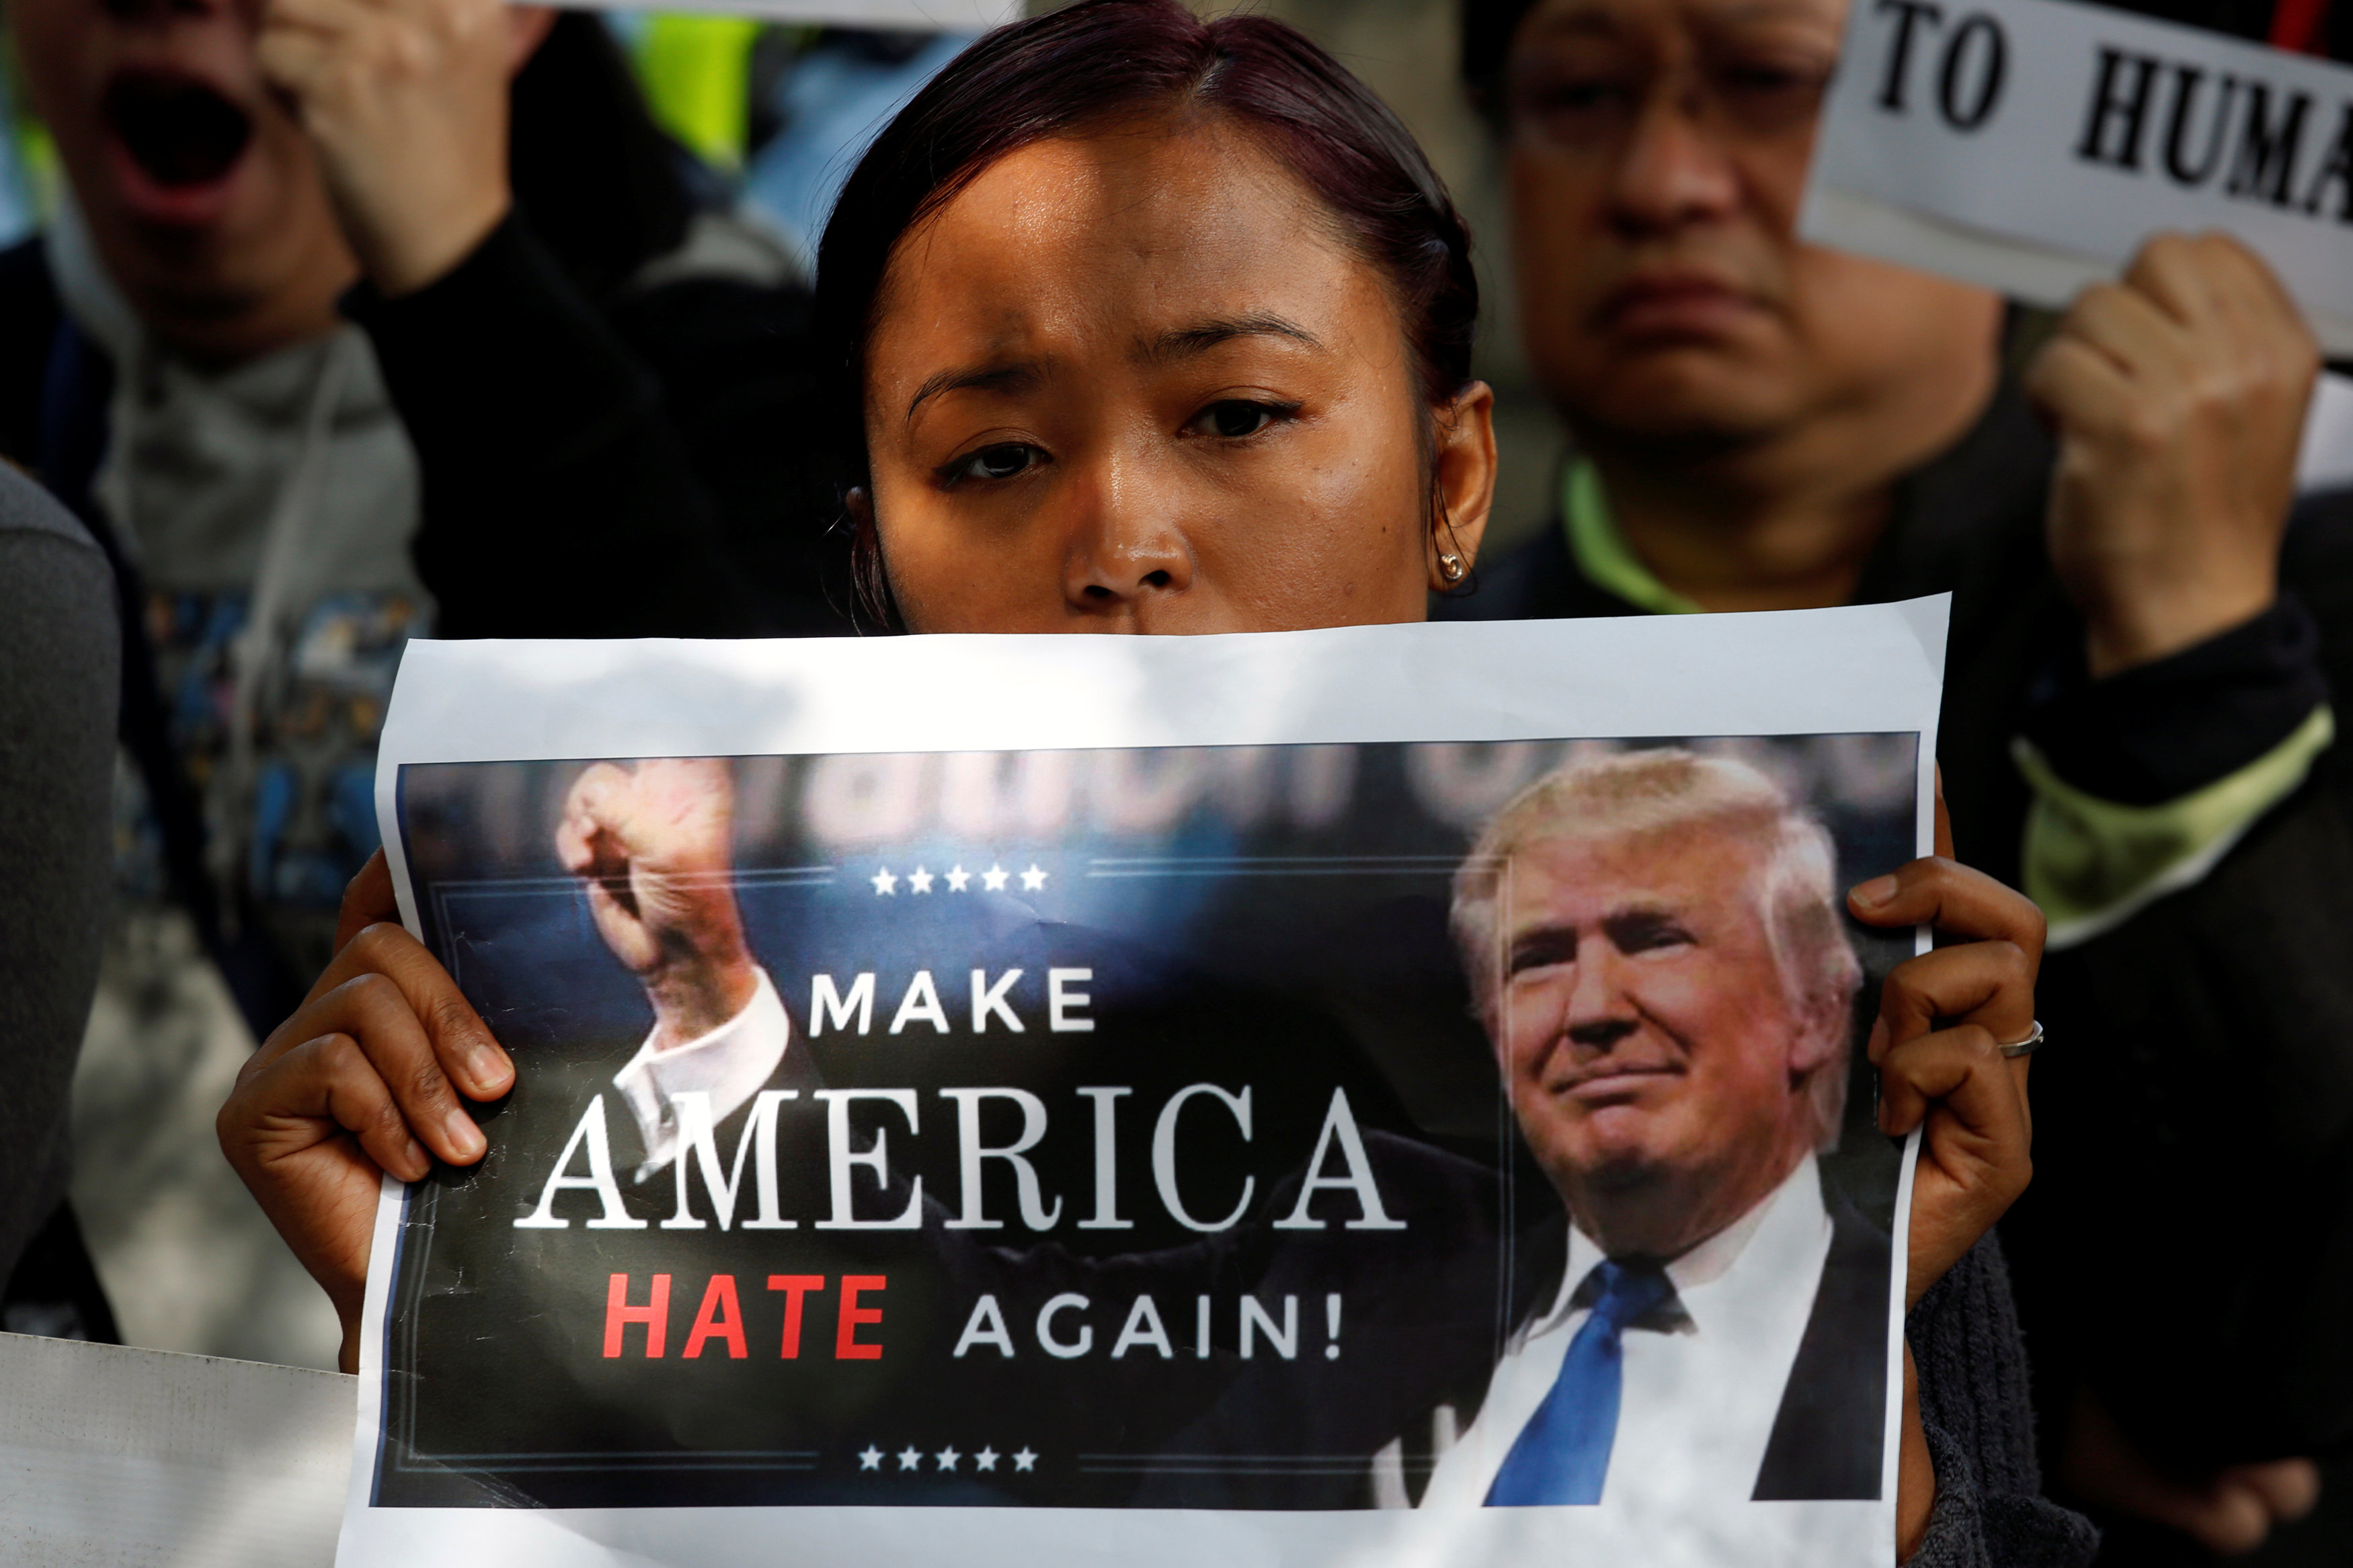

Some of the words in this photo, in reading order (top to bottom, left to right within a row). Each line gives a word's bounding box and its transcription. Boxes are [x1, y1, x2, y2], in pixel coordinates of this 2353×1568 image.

[1876, 1, 2008, 132] TO
[809, 968, 1095, 1037] MAKE
[513, 1083, 1407, 1233] AMERICA
[603, 1273, 887, 1360] HATE
[953, 1293, 1342, 1360] AGAIN!
